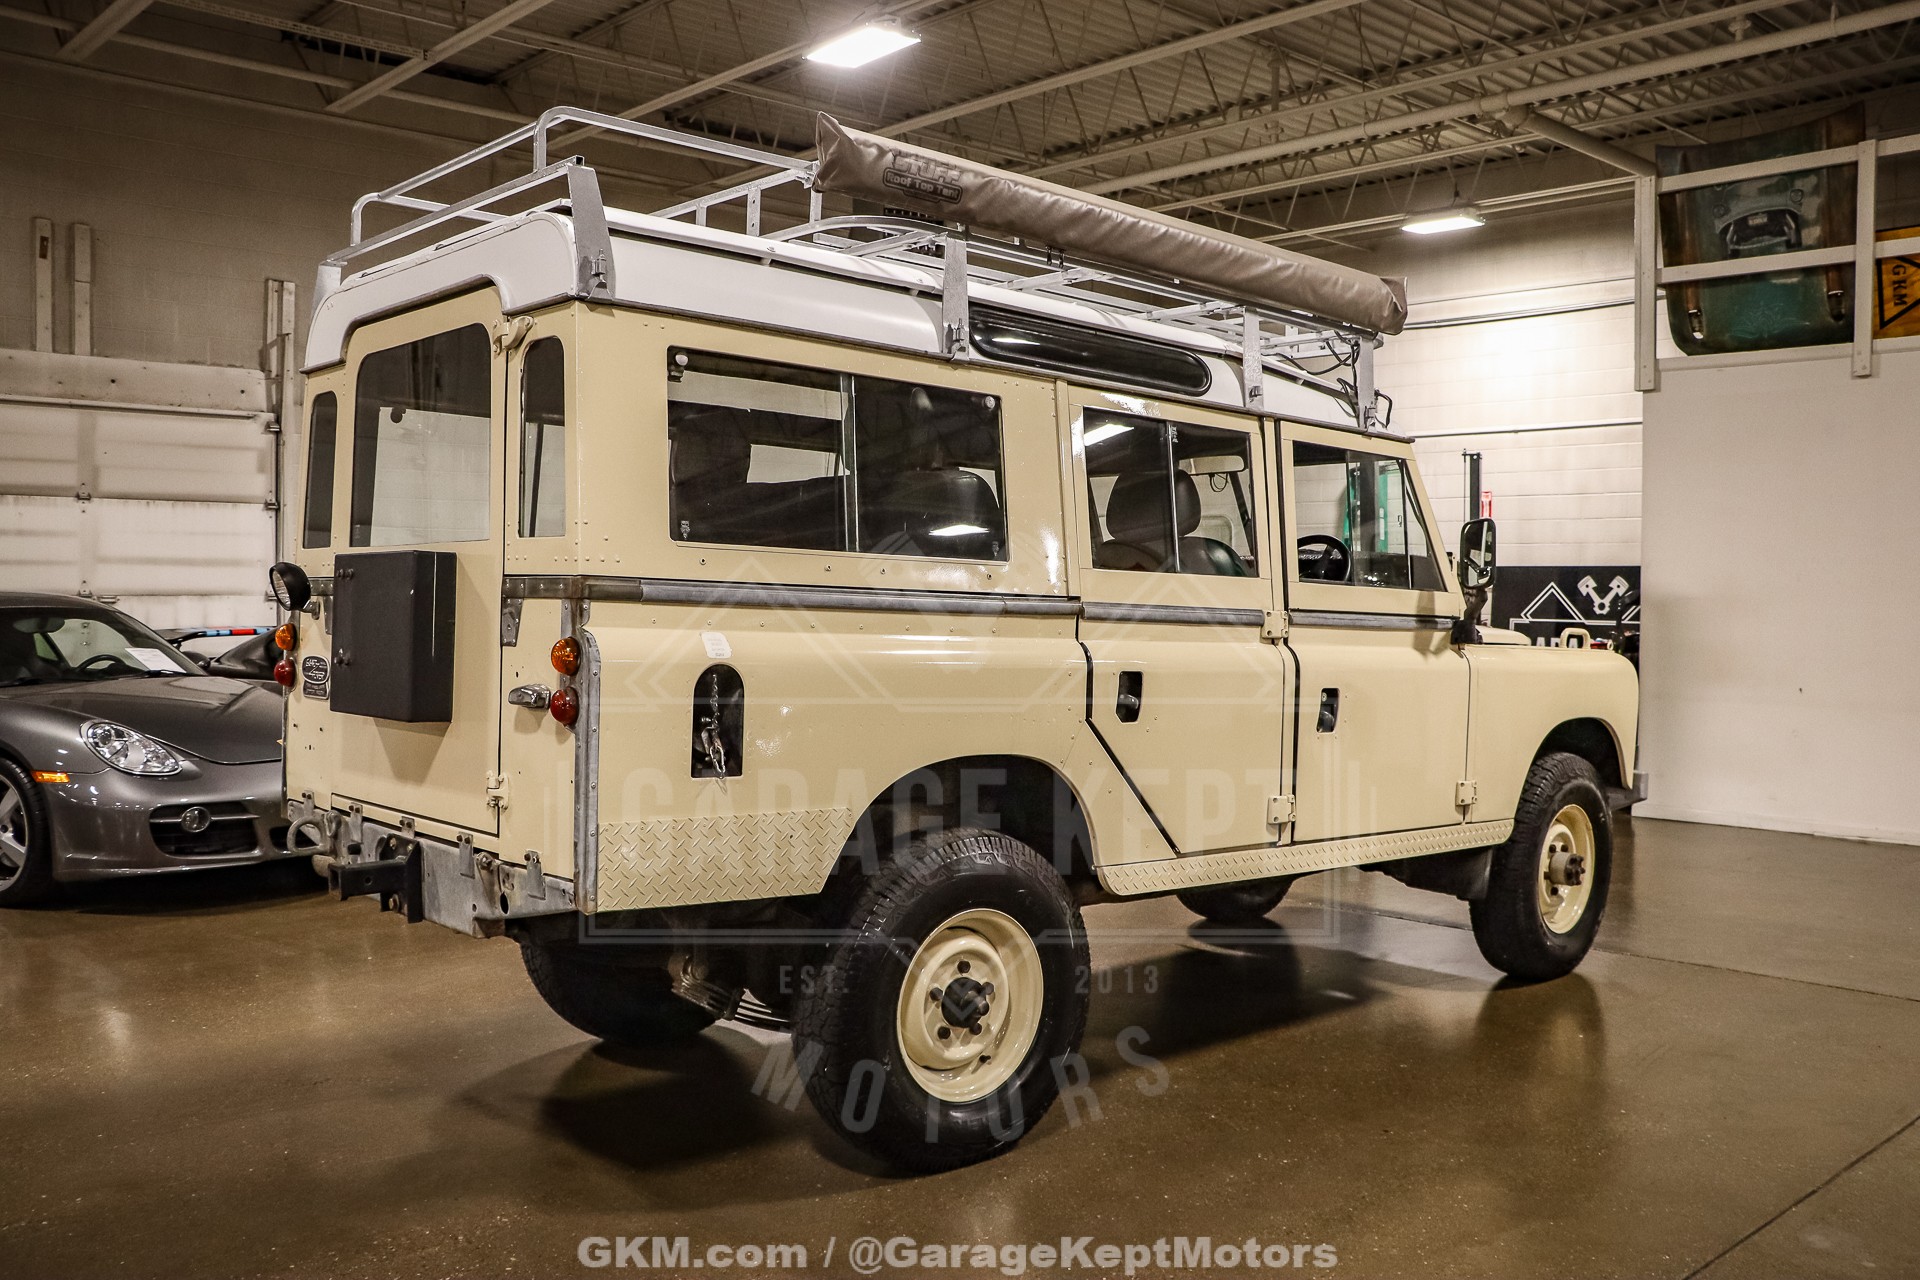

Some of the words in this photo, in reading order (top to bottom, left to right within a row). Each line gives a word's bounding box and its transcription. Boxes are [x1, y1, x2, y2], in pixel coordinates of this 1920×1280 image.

[886, 173, 912, 188] Roof
[914, 179, 934, 193] Top
[936, 185, 959, 199] Tent
[1891, 264, 1908, 307] GKM
